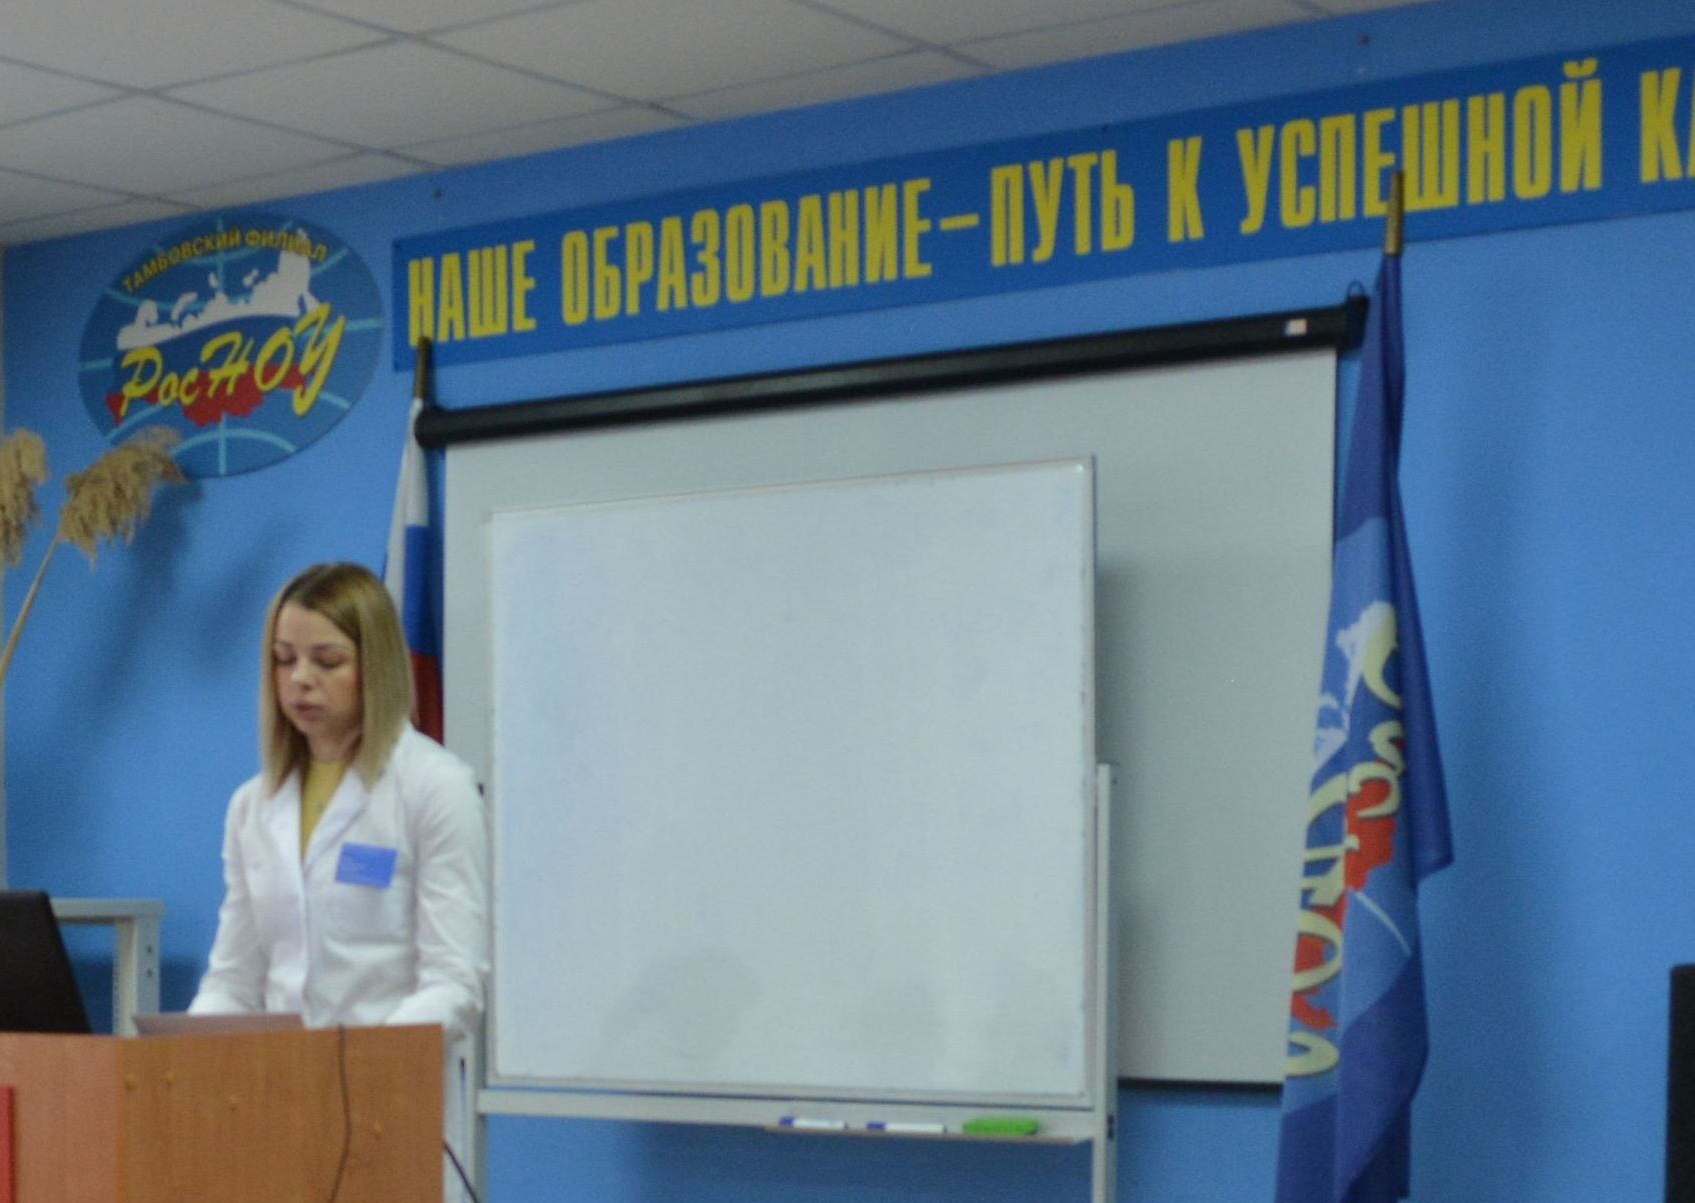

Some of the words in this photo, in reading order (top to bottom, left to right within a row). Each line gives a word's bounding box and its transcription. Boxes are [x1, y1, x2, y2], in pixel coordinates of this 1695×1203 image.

[408, 239, 537, 347] НАШЕ
[1167, 135, 1204, 243] К
[1236, 57, 1602, 236] УСПЕШНОЙ
[1640, 67, 1695, 184] К
